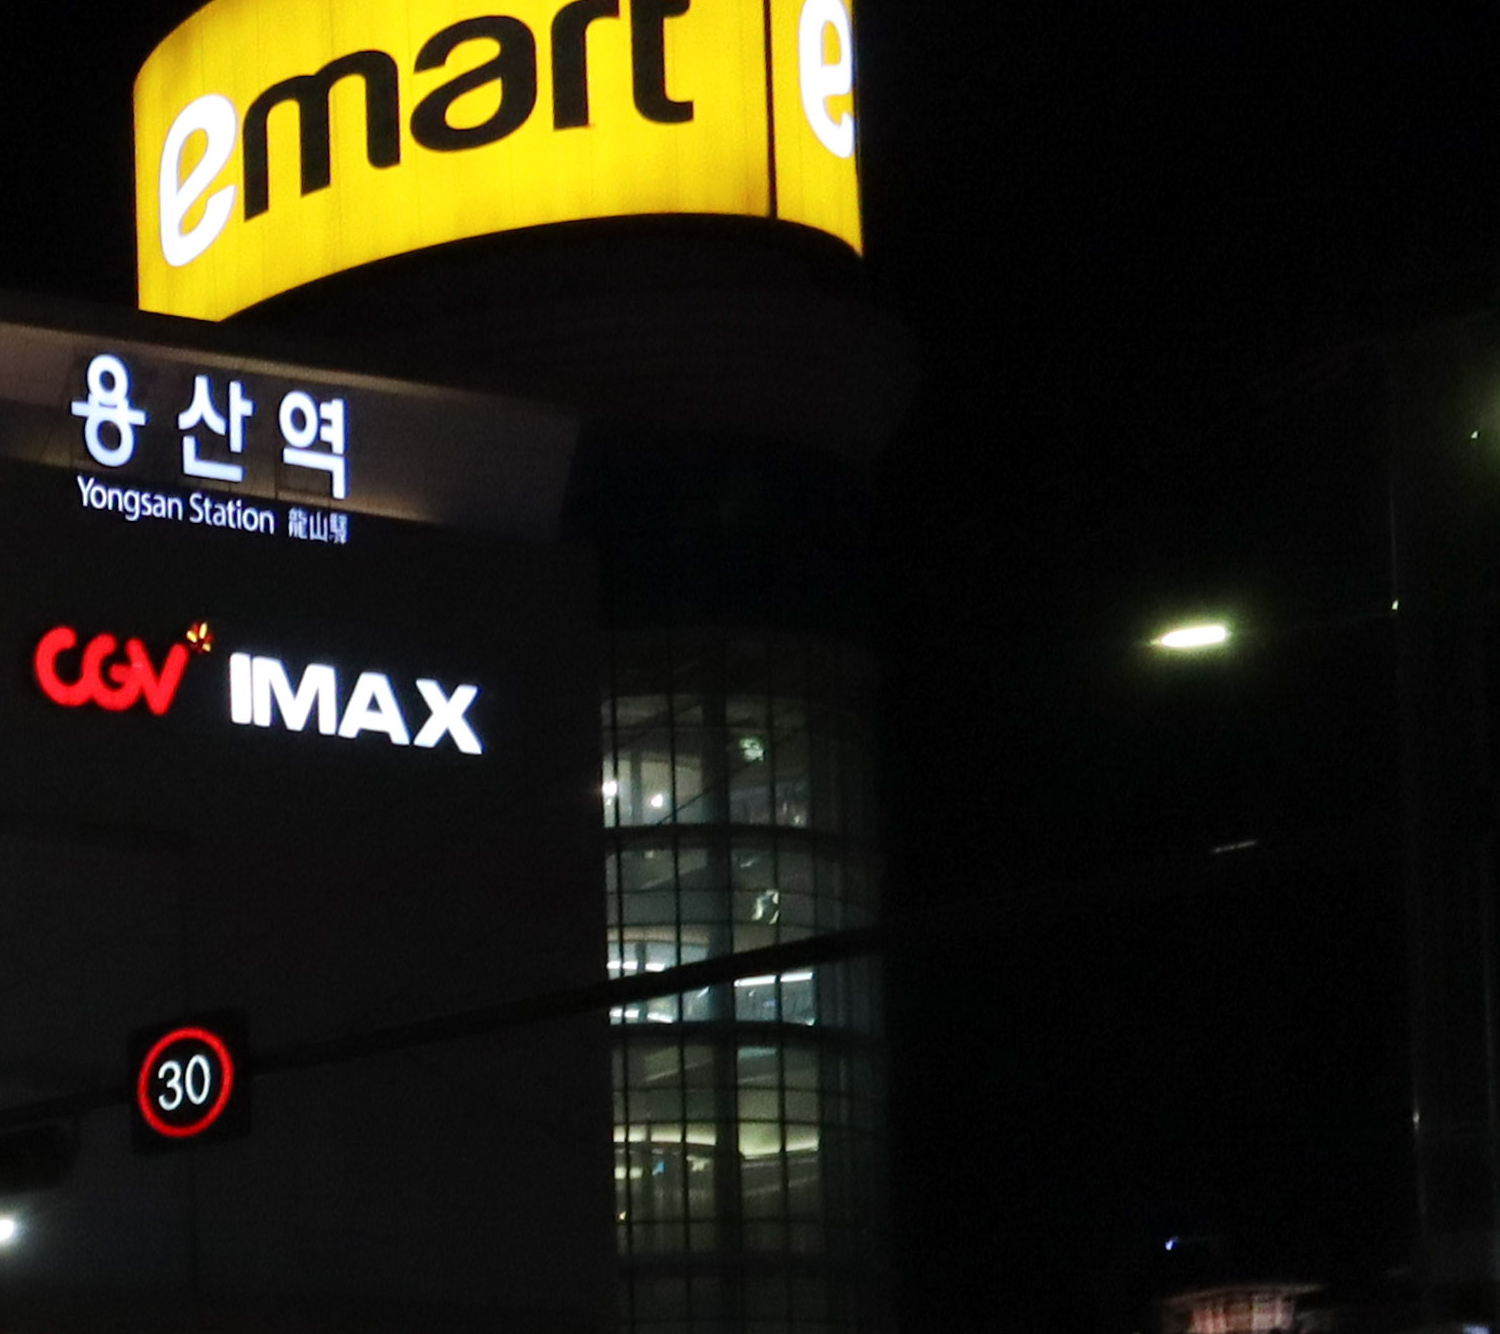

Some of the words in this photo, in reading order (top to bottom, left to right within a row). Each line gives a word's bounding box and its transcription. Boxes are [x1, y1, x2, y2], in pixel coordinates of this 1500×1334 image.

[76, 474, 184, 522] Yongsan
[189, 492, 275, 535] Station
[34, 625, 190, 716] CGV
[229, 652, 484, 756] IMAX
[157, 1054, 212, 1111] 30
